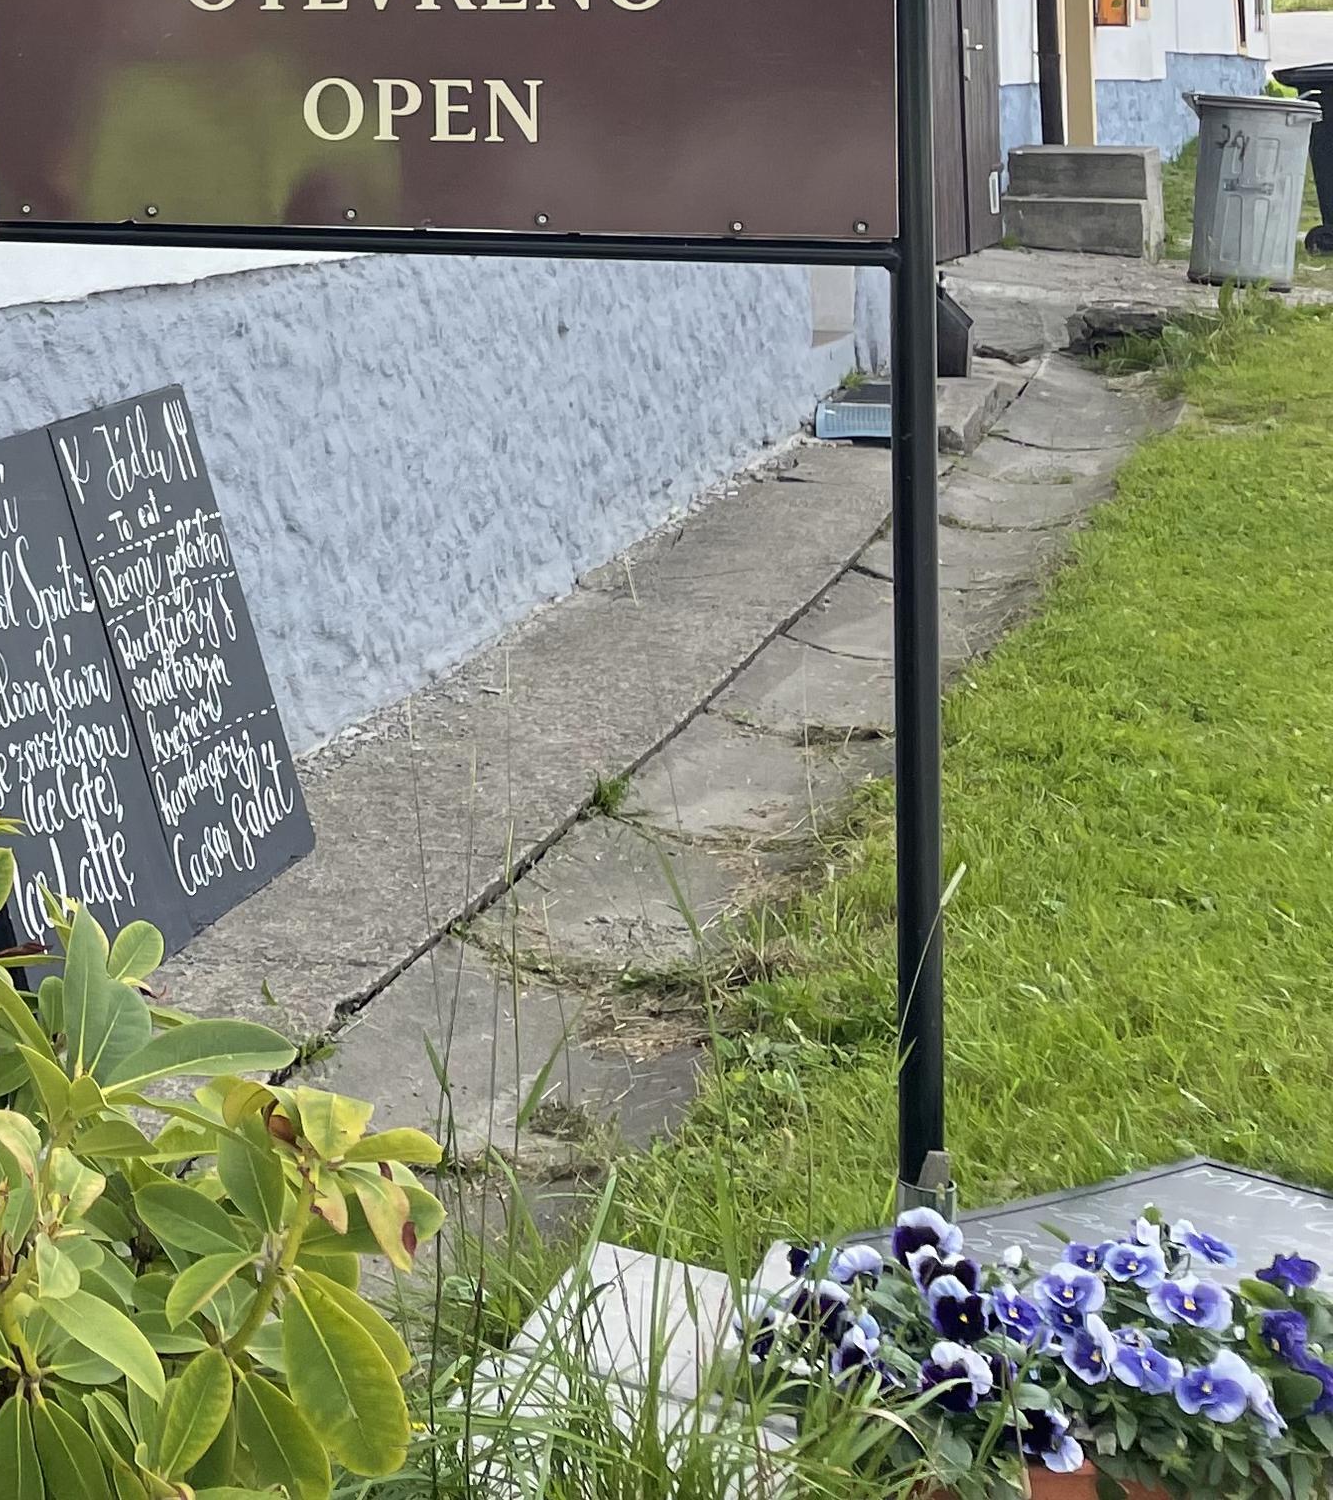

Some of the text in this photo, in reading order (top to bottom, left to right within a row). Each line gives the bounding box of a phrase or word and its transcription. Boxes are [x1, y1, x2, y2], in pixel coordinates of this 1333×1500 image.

[302, 77, 544, 144] OPEN
[58, 435, 91, 505] K
[108, 488, 161, 542] To eat
[14, 535, 96, 638] Spritz
